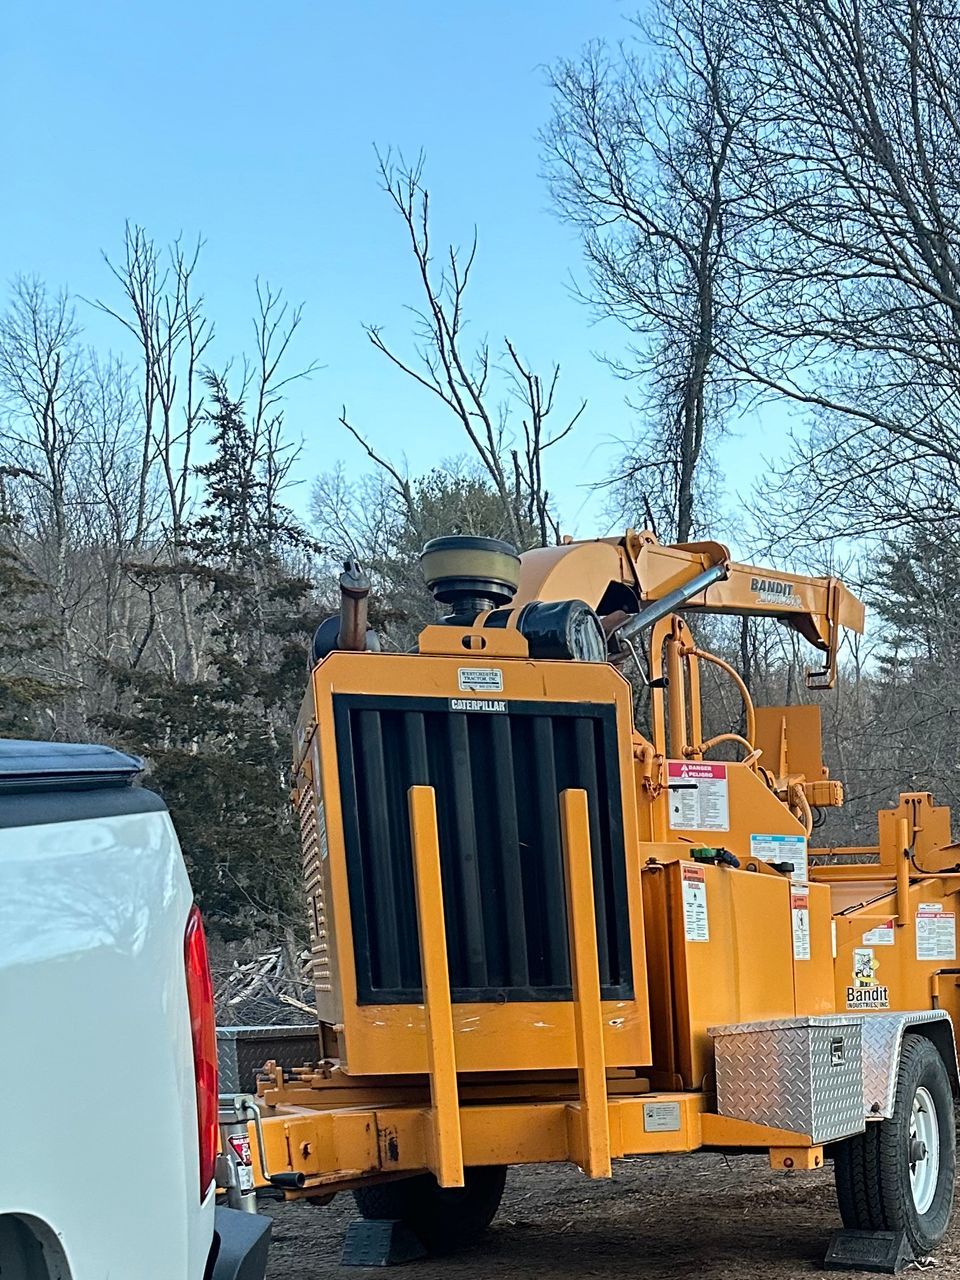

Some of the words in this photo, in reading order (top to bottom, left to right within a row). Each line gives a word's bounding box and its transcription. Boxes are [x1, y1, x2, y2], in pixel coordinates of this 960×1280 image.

[751, 577, 793, 597] BANDIT
[451, 699, 506, 711] CATERPILLAR
[847, 987, 888, 1001] Bandit
